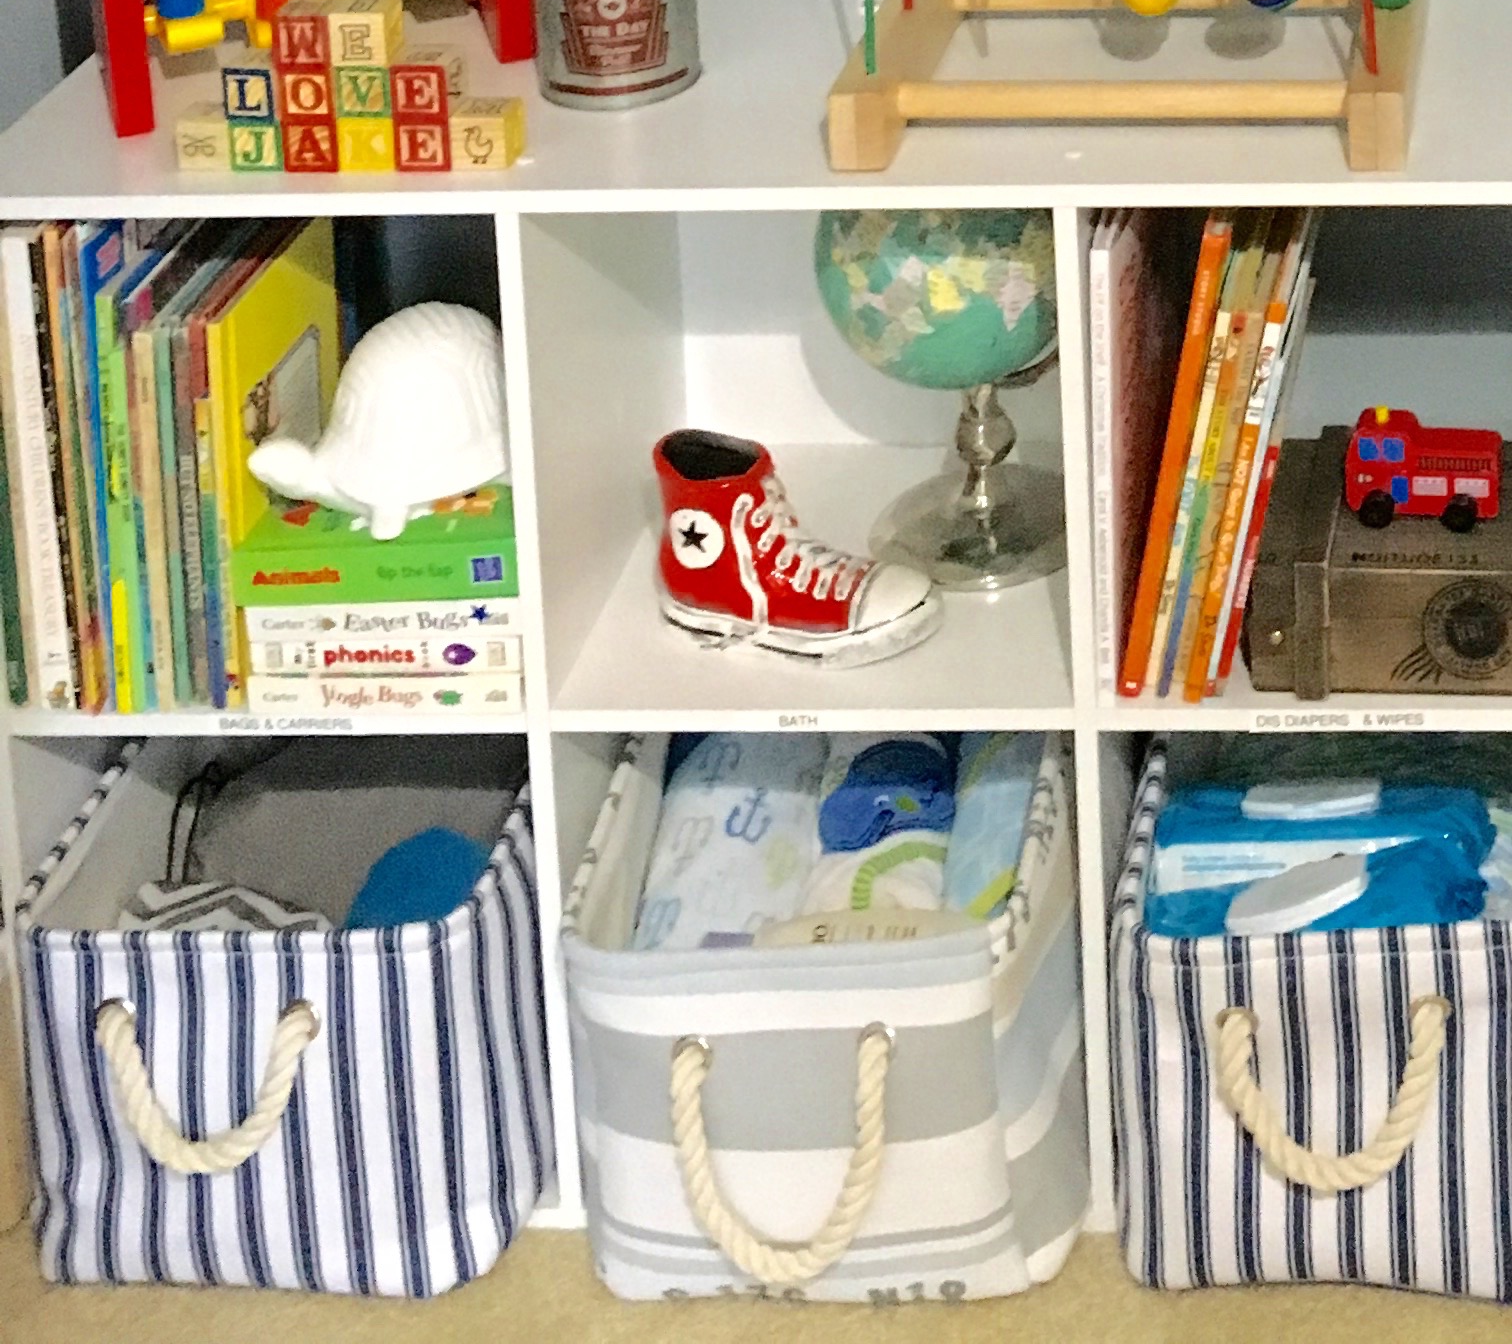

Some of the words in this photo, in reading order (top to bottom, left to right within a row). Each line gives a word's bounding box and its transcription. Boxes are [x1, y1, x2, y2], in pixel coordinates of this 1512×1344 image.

[284, 16, 373, 61] WE
[231, 74, 434, 114] LOVE
[179, 455, 195, 486] BUT
[1235, 459, 1250, 485] NOT
[181, 489, 197, 514] NO
[182, 516, 201, 610] ELEPHANTS
[252, 567, 340, 587] Animals
[416, 611, 469, 631] Bugs
[323, 643, 416, 667] phonics
[377, 684, 424, 709] Bugs
[219, 717, 260, 730] BAGS
[276, 717, 353, 731] CARRIERS
[778, 715, 818, 728] BATH
[1285, 714, 1350, 727] DIAPERS
[1376, 713, 1424, 726] WIPES
